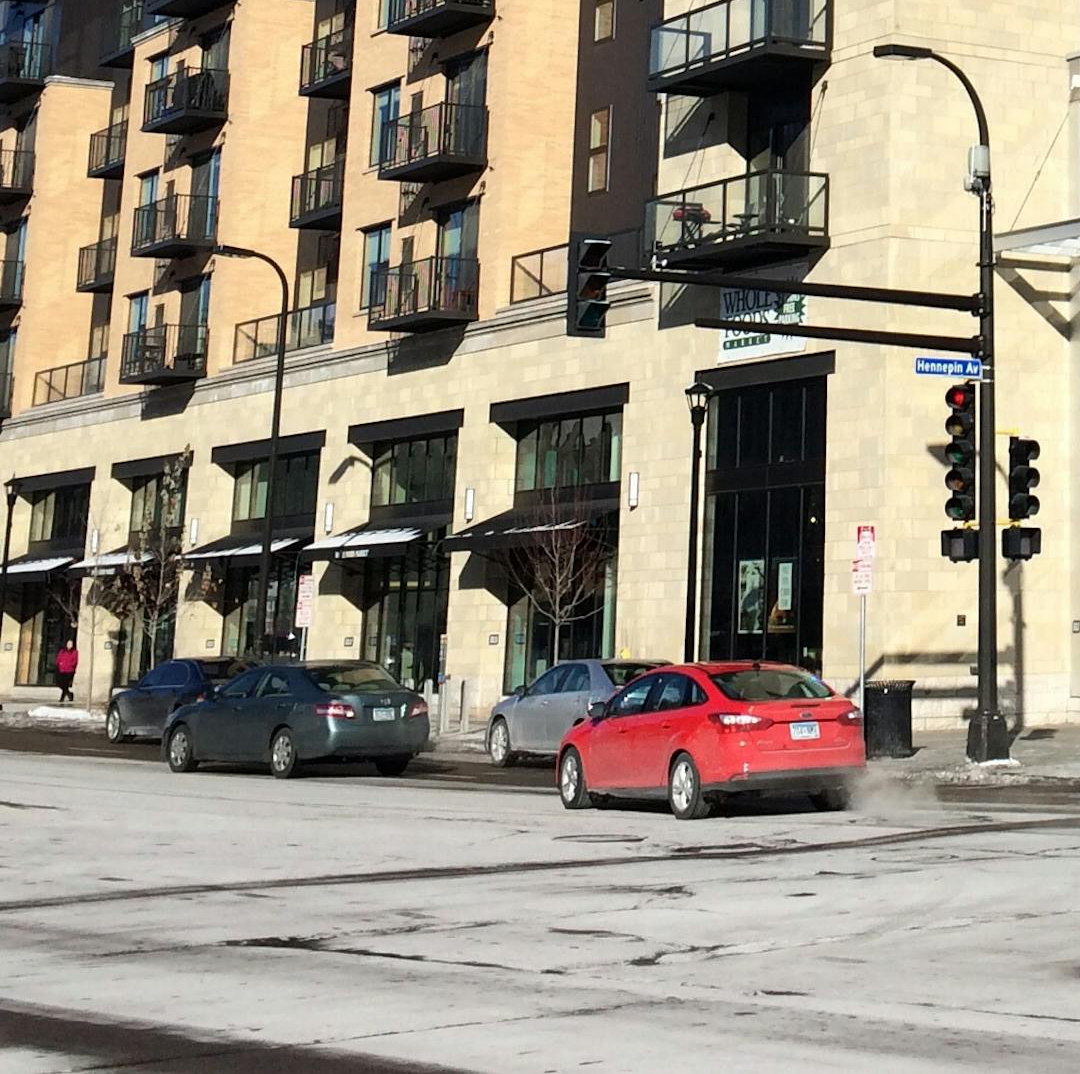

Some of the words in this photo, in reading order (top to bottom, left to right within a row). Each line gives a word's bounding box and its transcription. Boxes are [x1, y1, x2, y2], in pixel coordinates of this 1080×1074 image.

[723, 288, 773, 314] WHOLE
[917, 359, 963, 376] Hennepin
[966, 362, 979, 374] Av
